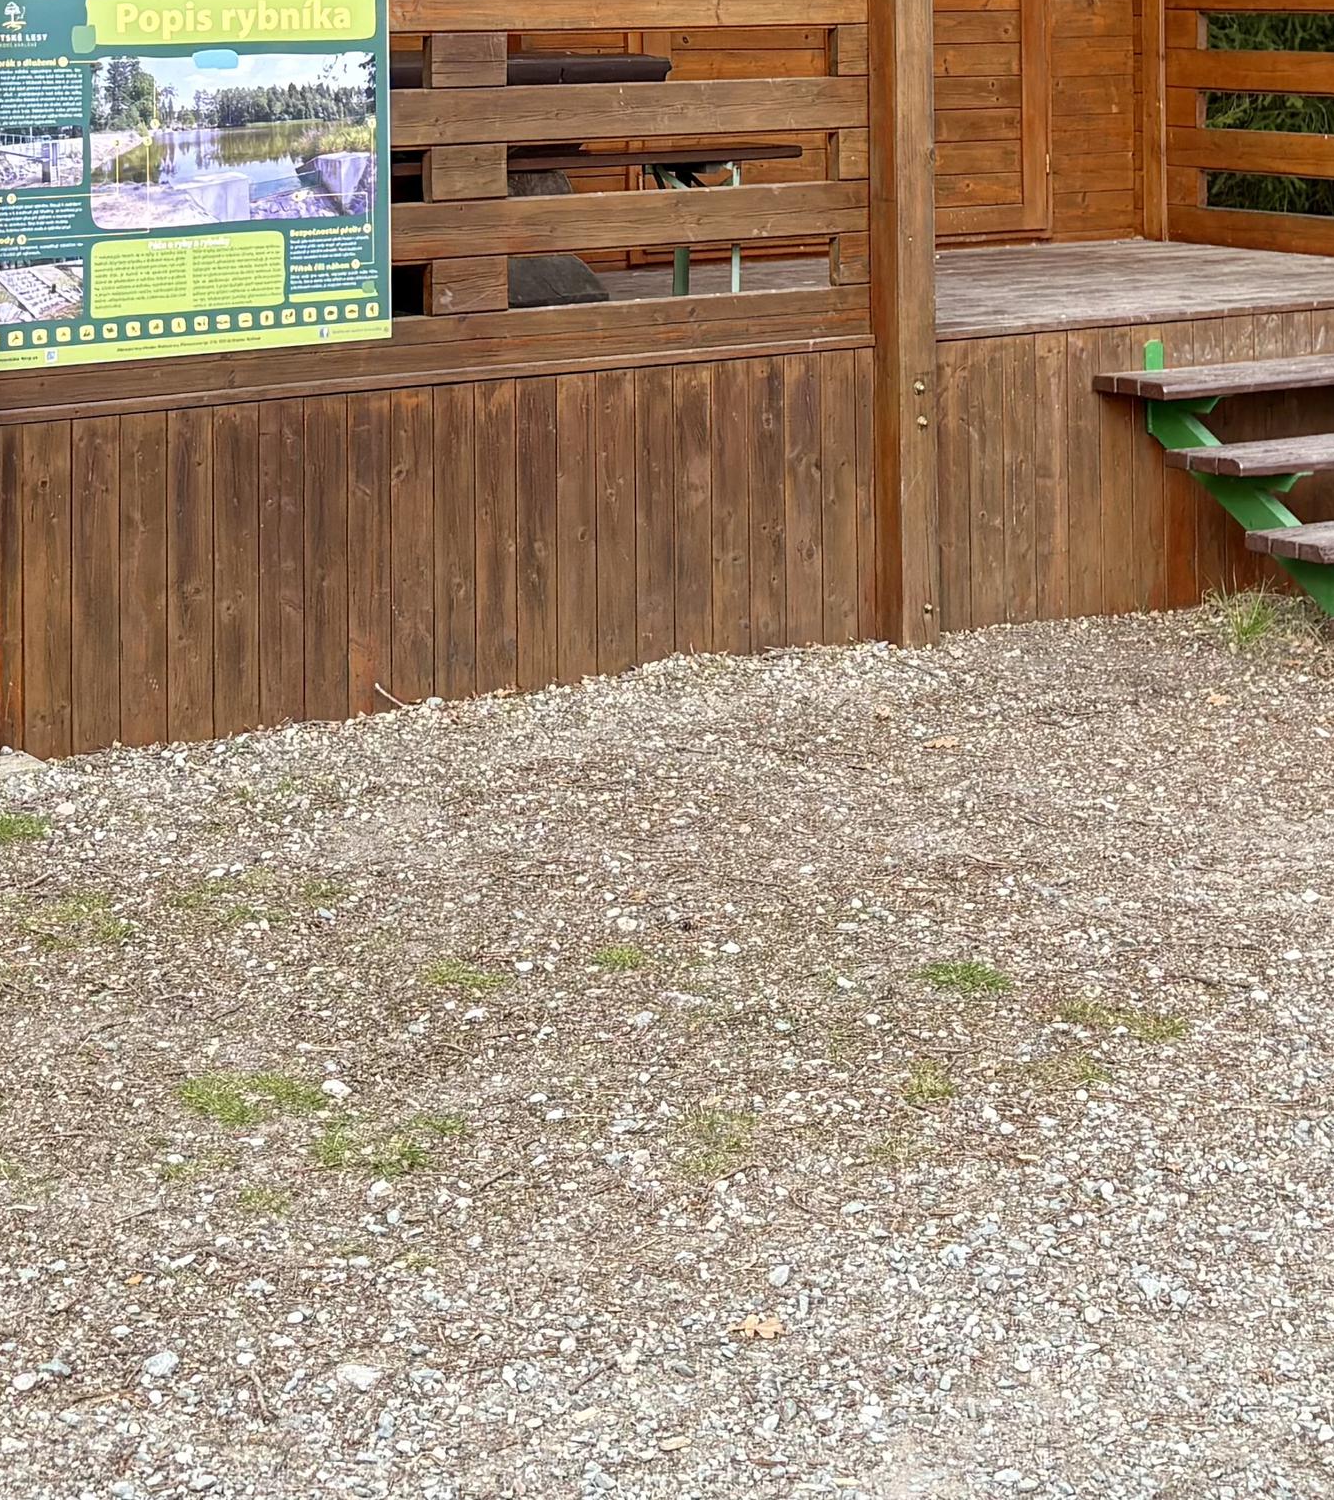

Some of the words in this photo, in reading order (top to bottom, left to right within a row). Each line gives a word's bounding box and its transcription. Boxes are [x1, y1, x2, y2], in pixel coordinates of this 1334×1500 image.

[116, 1, 213, 40] Popis
[221, 0, 351, 39] rybníka
[26, 33, 48, 41] LESY
